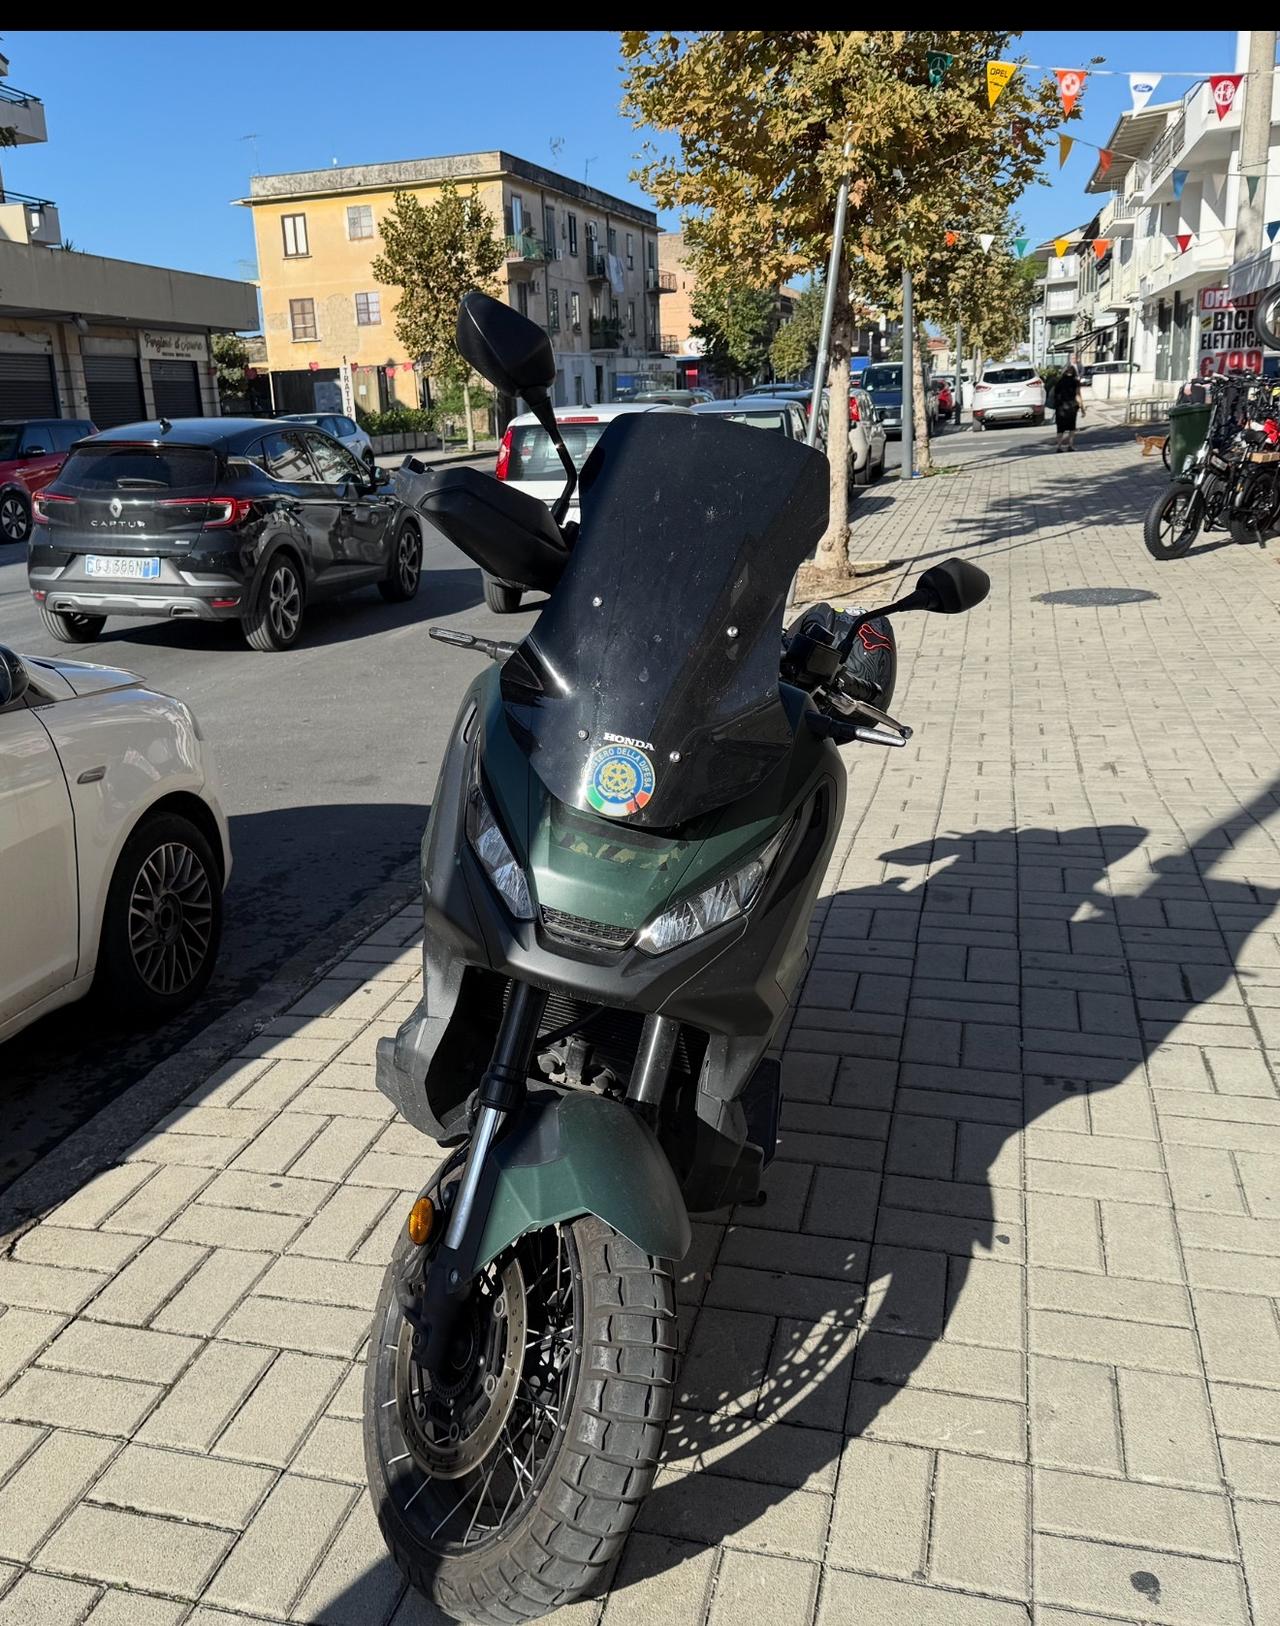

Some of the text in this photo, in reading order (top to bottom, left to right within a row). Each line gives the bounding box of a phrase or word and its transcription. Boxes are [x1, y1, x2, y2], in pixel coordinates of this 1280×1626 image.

[990, 67, 1008, 78] OPEL
[1213, 310, 1254, 331] BICI
[90, 520, 146, 528] CAPTUR
[603, 732, 655, 751] HONDA
[616, 747, 640, 763] DELLA
[639, 760, 652, 787] DIFESA
